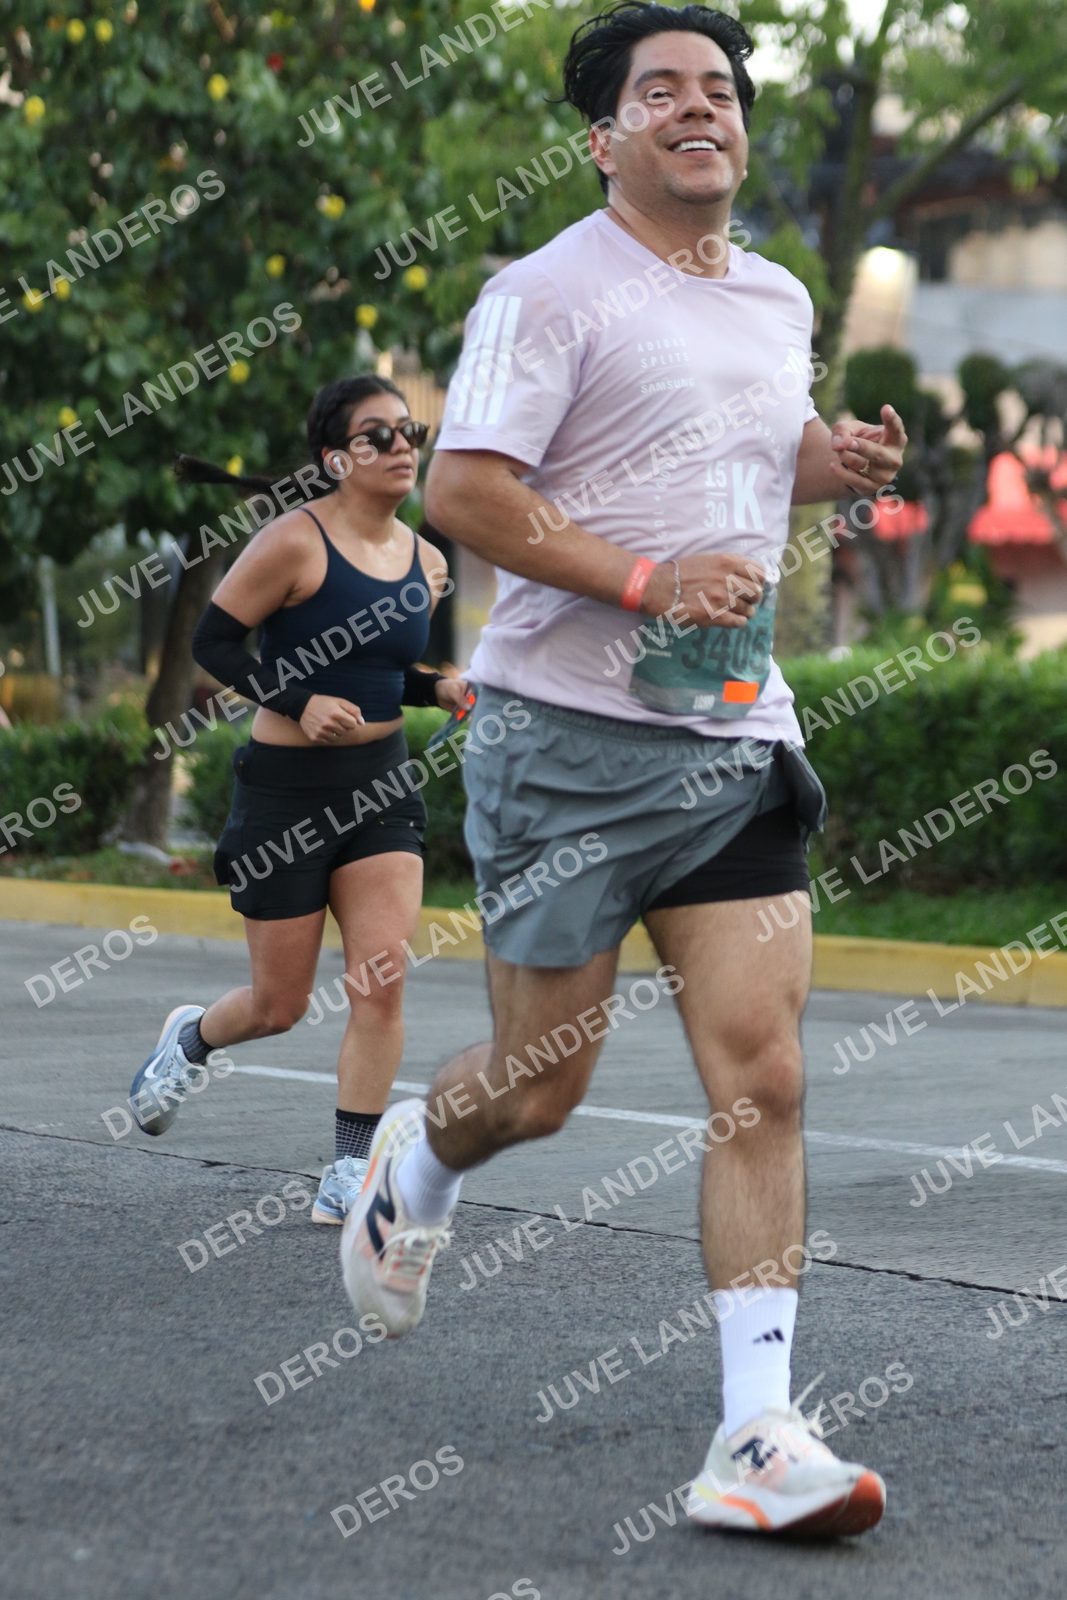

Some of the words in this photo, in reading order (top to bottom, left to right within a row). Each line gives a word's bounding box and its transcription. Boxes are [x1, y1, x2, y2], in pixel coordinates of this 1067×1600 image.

[640, 377, 696, 394] SAMSUNG
[705, 461, 727, 488] 15
[732, 462, 765, 531] K
[703, 501, 727, 529] 30
